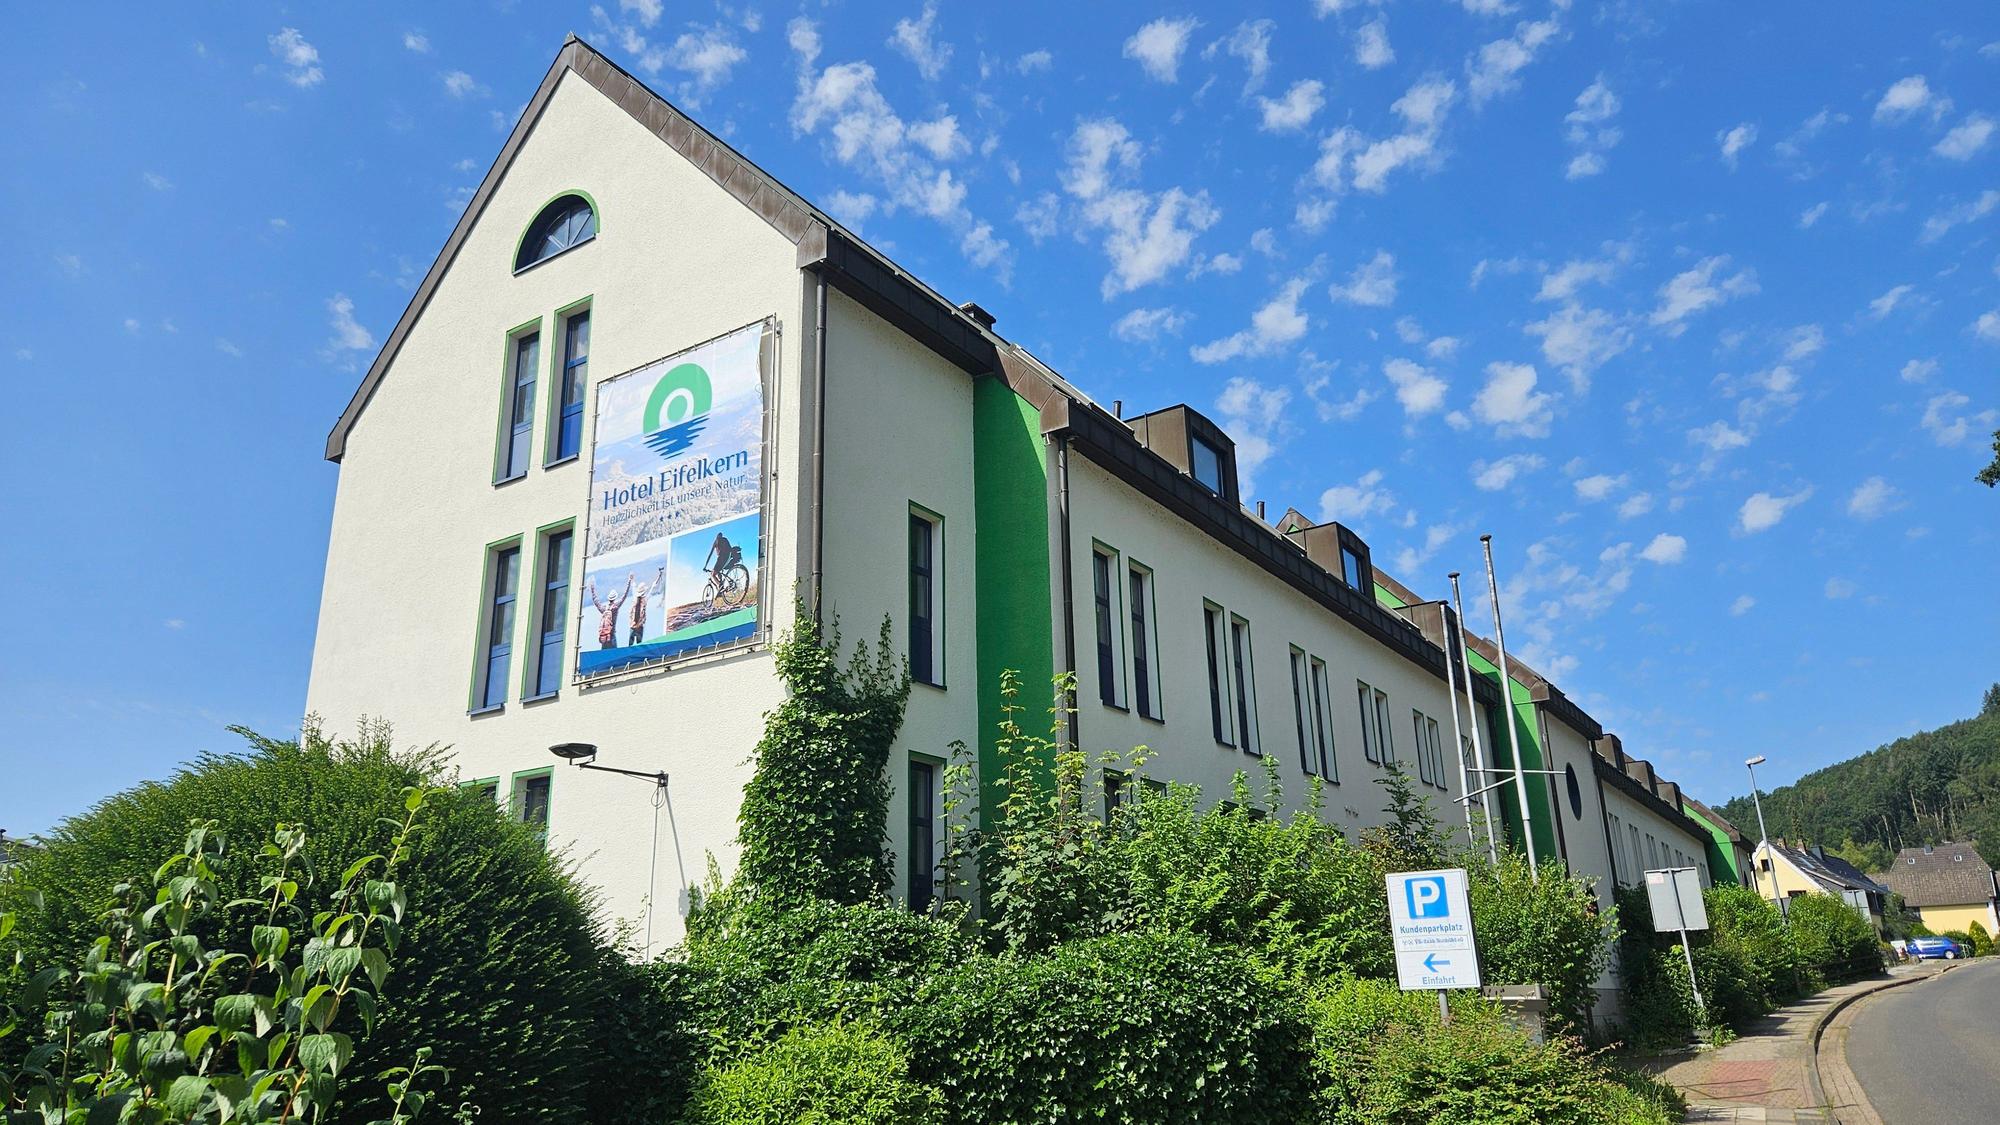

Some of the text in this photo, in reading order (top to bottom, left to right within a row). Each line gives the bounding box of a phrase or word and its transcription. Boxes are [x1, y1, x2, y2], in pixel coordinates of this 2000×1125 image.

[604, 450, 748, 510] Hotel Eifelkern
[602, 500, 659, 527] Herzlichkeit
[662, 497, 675, 509] ist
[677, 485, 712, 504] unsere
[1411, 880, 1440, 916] P
[1400, 923, 1463, 934] Kundenparkplatz
[1422, 976, 1456, 985] Einfahrt
